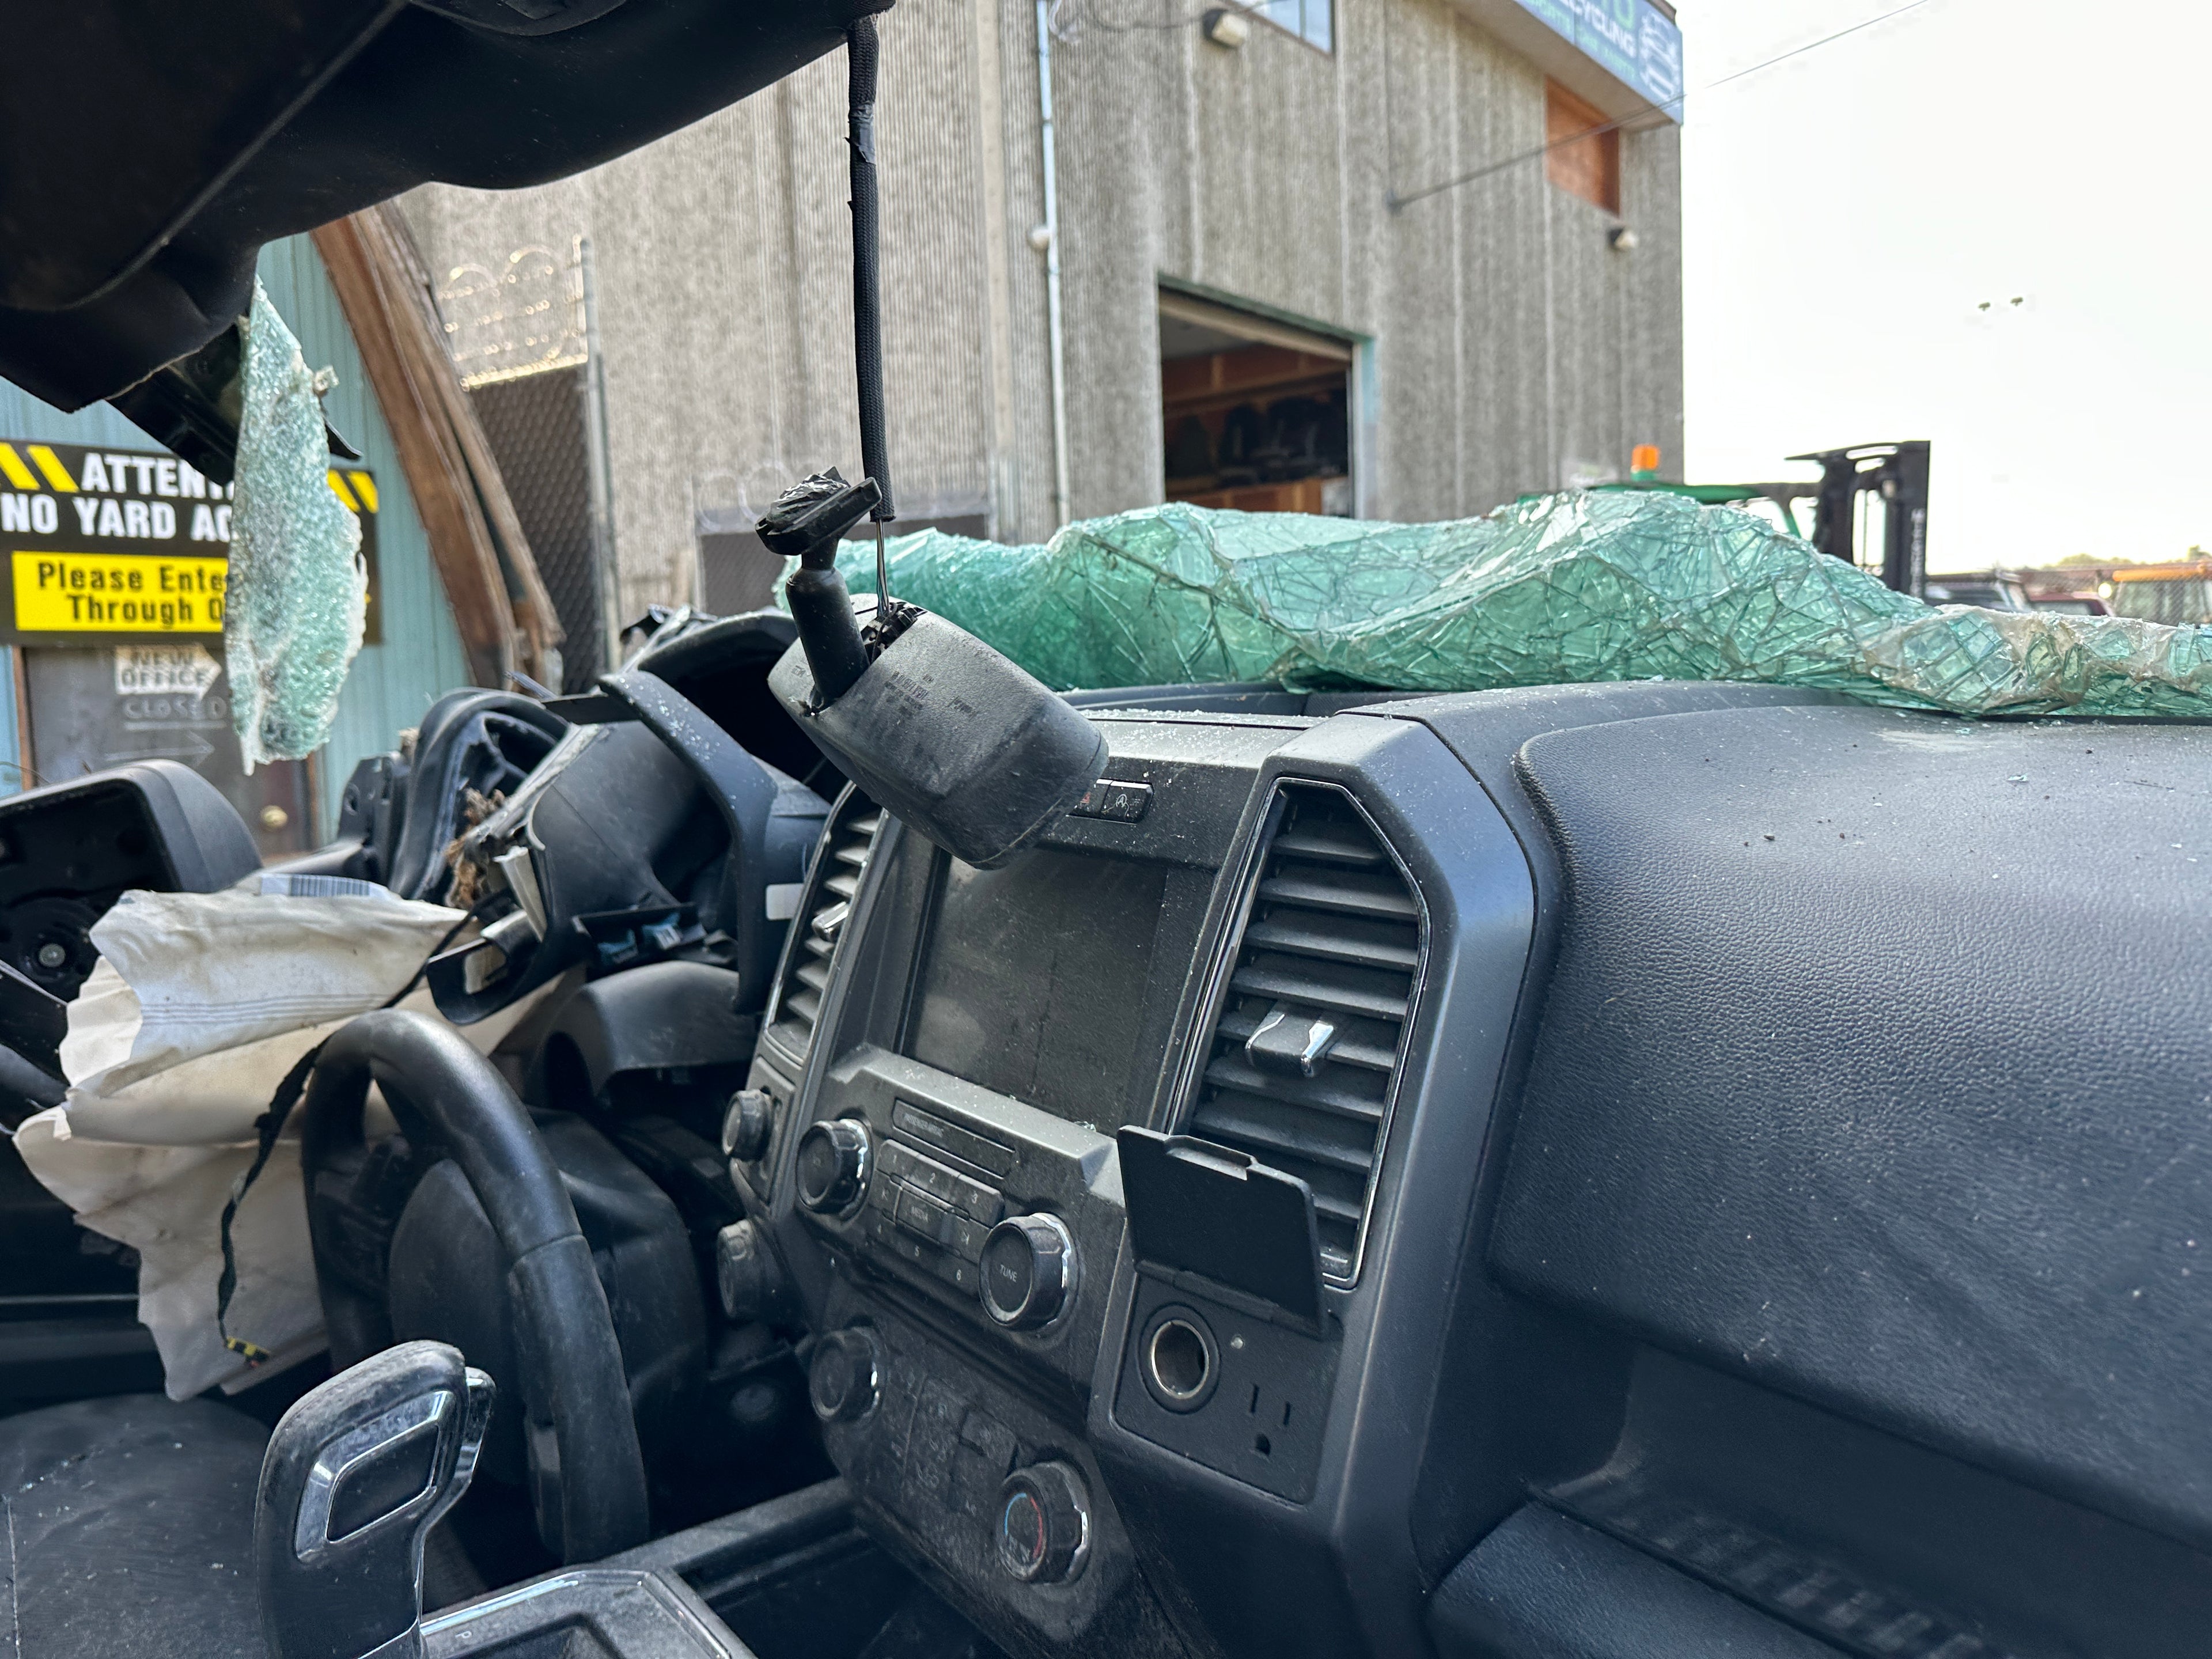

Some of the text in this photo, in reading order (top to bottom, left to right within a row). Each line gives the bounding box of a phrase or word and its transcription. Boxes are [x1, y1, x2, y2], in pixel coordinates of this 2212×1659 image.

[1560, 0, 1637, 58] CYCLING
[1, 492, 58, 534] NO
[72, 497, 176, 539] YARD
[37, 561, 143, 591] Please
[67, 596, 192, 628] Through
[131, 650, 194, 666] NEW
[121, 670, 205, 687] OFFICE
[123, 696, 227, 720] CLOSED
[929, 1172, 936, 1184] 2
[971, 1191, 978, 1205] 3
[914, 1245, 921, 1257] 5
[956, 1269, 962, 1282] 6
[1000, 1264, 1018, 1283] TUNE
